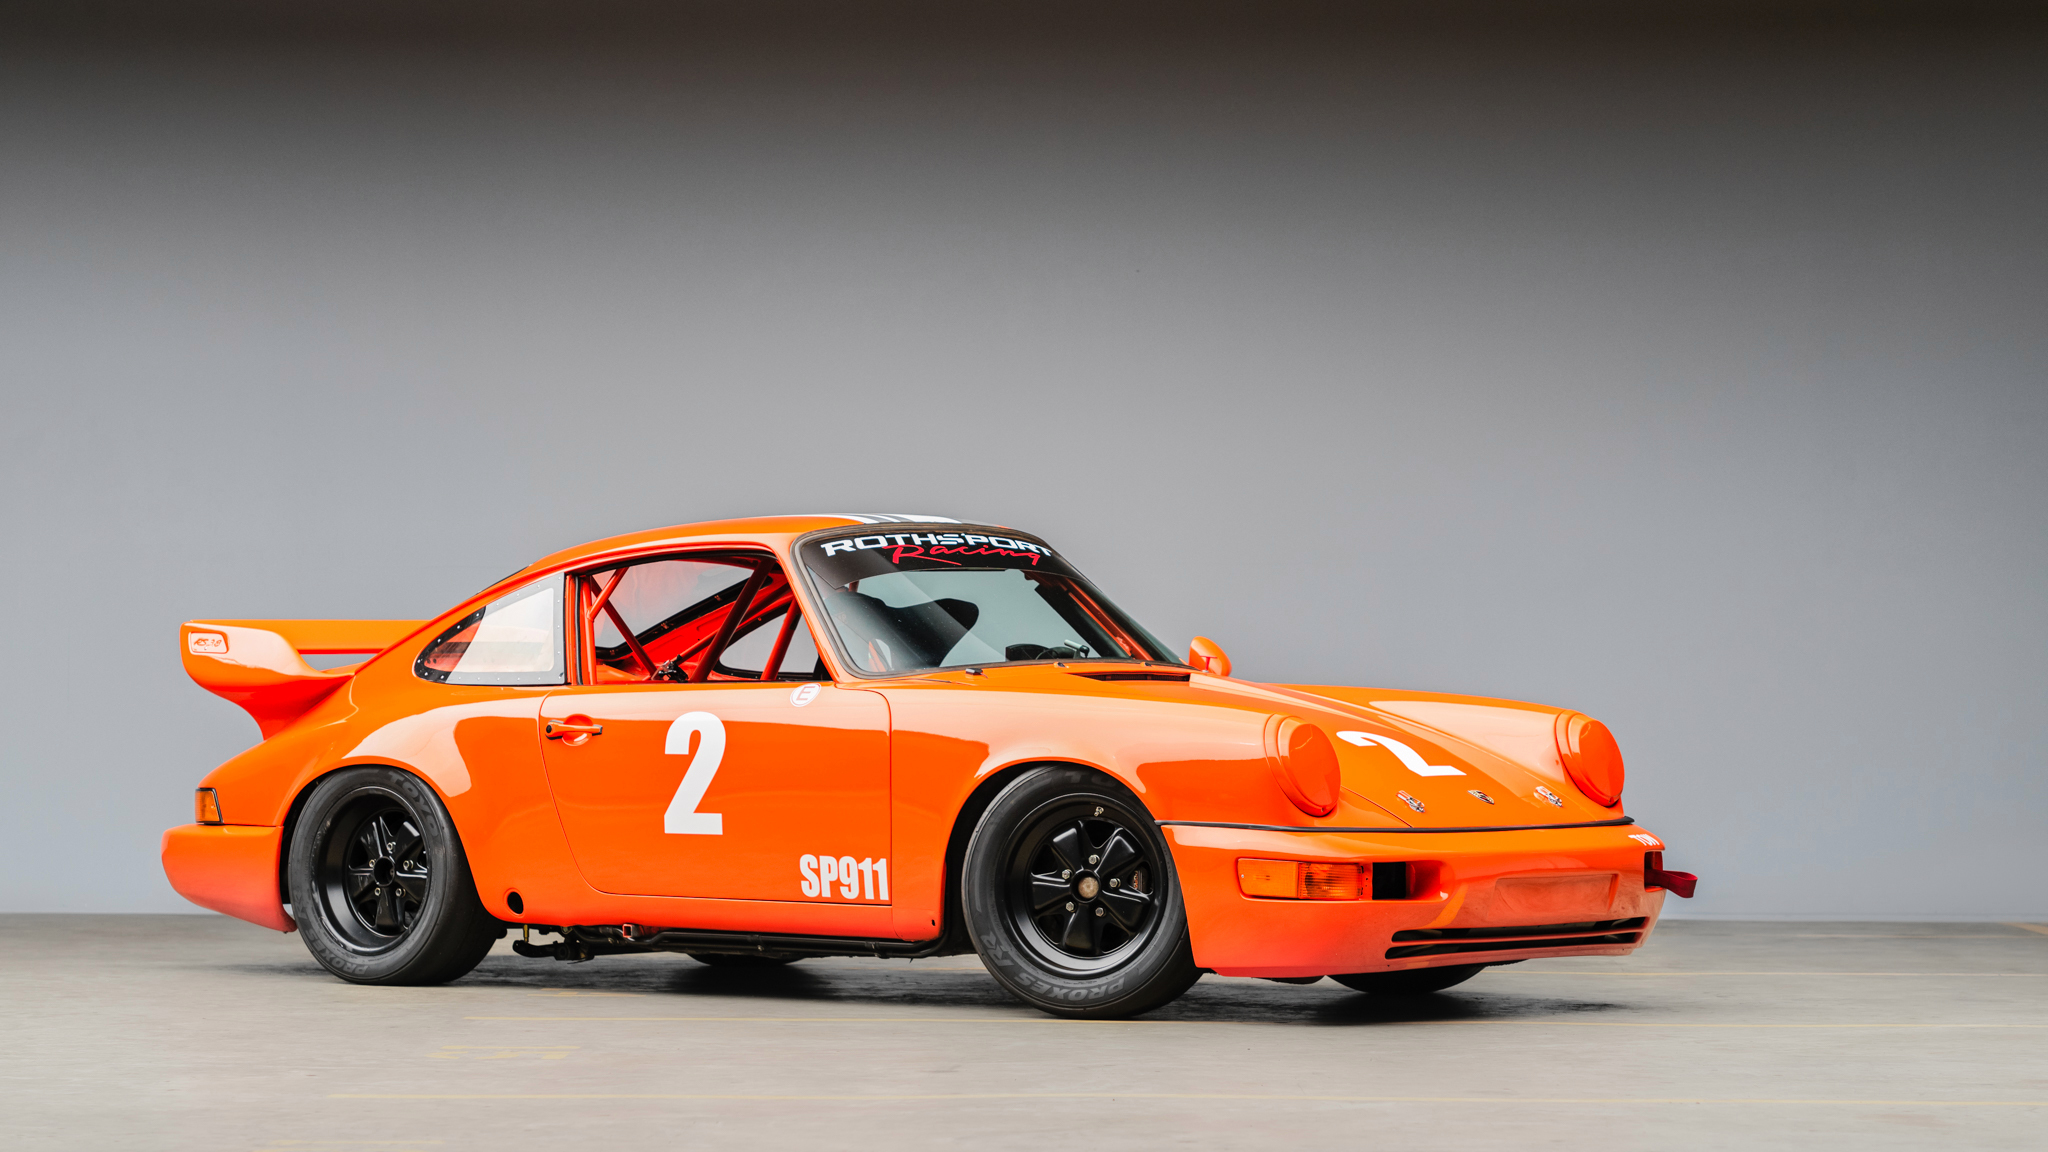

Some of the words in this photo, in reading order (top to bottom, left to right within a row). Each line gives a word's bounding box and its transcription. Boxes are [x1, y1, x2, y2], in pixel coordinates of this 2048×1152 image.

[820, 533, 1052, 557] ROTHSPORT
[882, 544, 1041, 566] Racing
[664, 711, 726, 835] 2
[1336, 731, 1467, 776] 2
[388, 771, 439, 838] TOYO
[800, 854, 889, 901] SP911
[308, 930, 369, 976] PROXES
[1013, 974, 1126, 1002] PROXES
